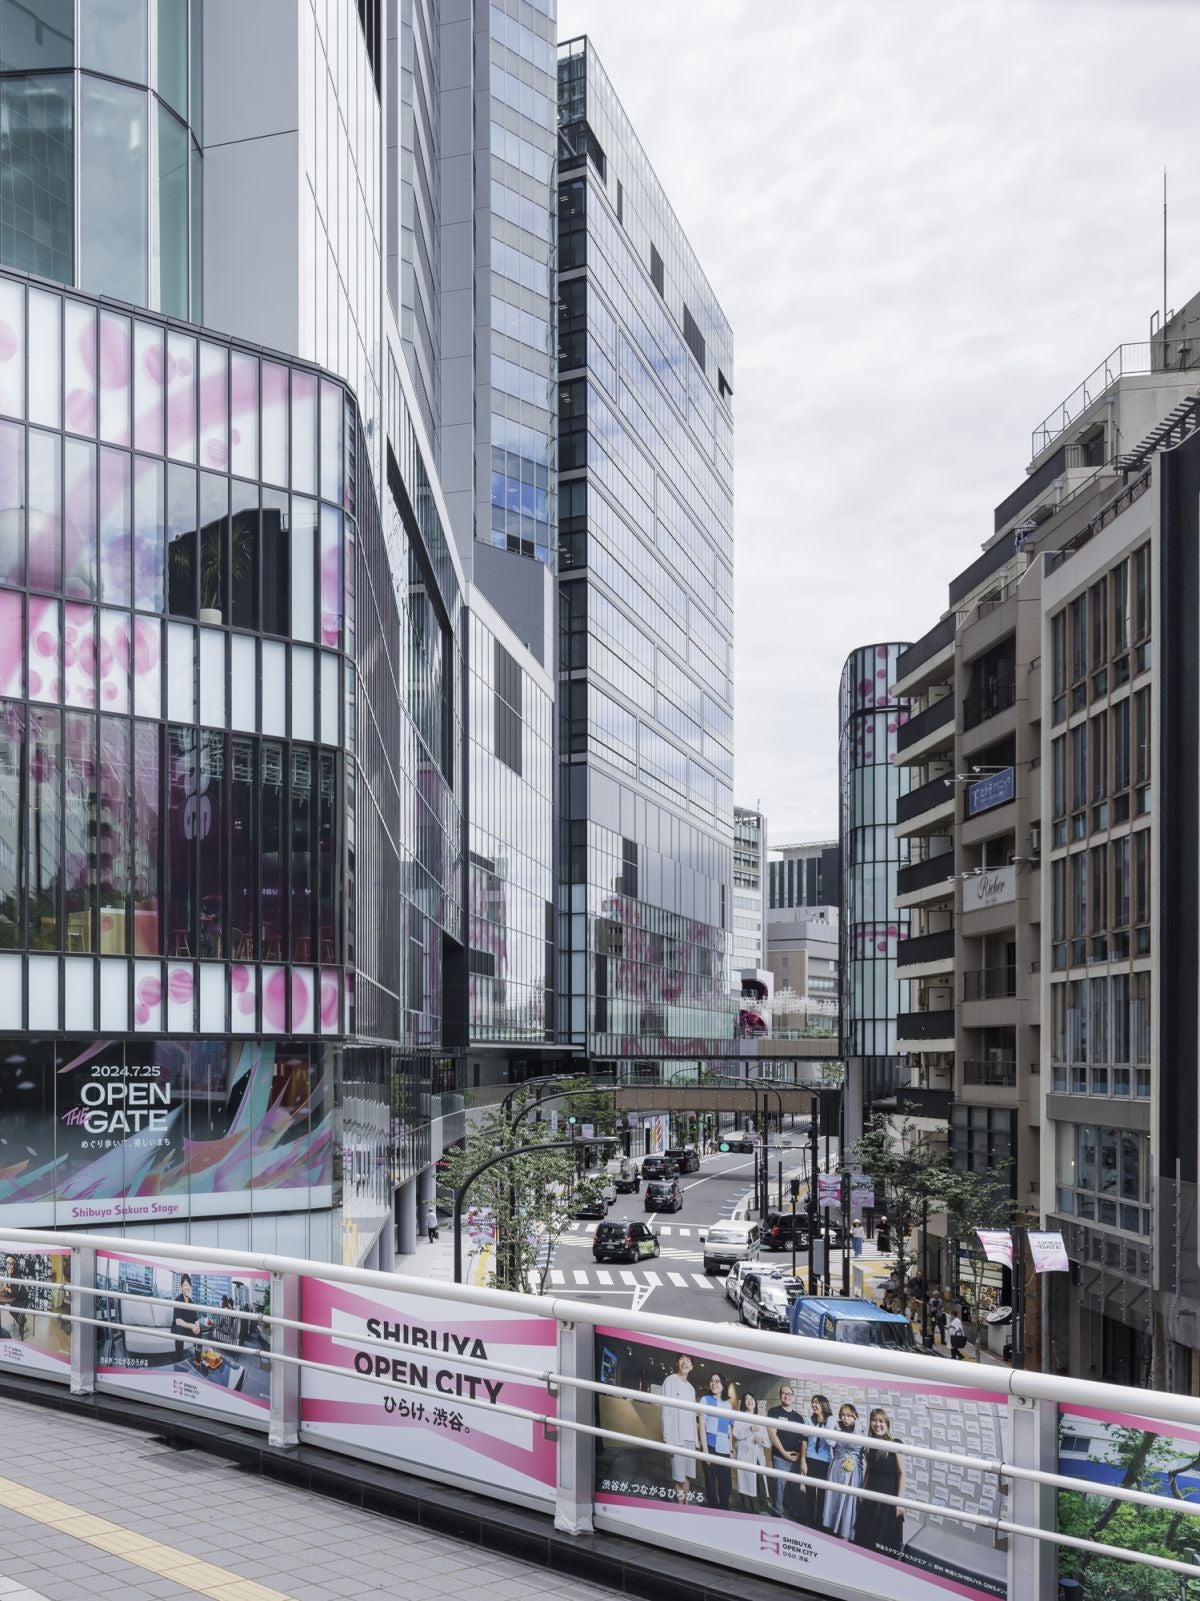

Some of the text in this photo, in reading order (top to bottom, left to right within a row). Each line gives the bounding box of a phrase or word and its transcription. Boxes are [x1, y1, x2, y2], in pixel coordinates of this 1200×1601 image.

[91, 1065, 161, 1077] 2024.7.25
[80, 1082, 171, 1106] OPEN
[61, 1106, 168, 1134] THE GATE
[72, 1202, 179, 1218] Shibuya Sakura Stage
[354, 1351, 504, 1405] OPEN CITY
[383, 1395, 471, 1434] ひらけ、渋谷。
[602, 1480, 704, 1503] 渋谷が、つながるひろがる
[782, 1536, 812, 1549] SHIBUYA
[782, 1543, 818, 1558] OPEN CITY
